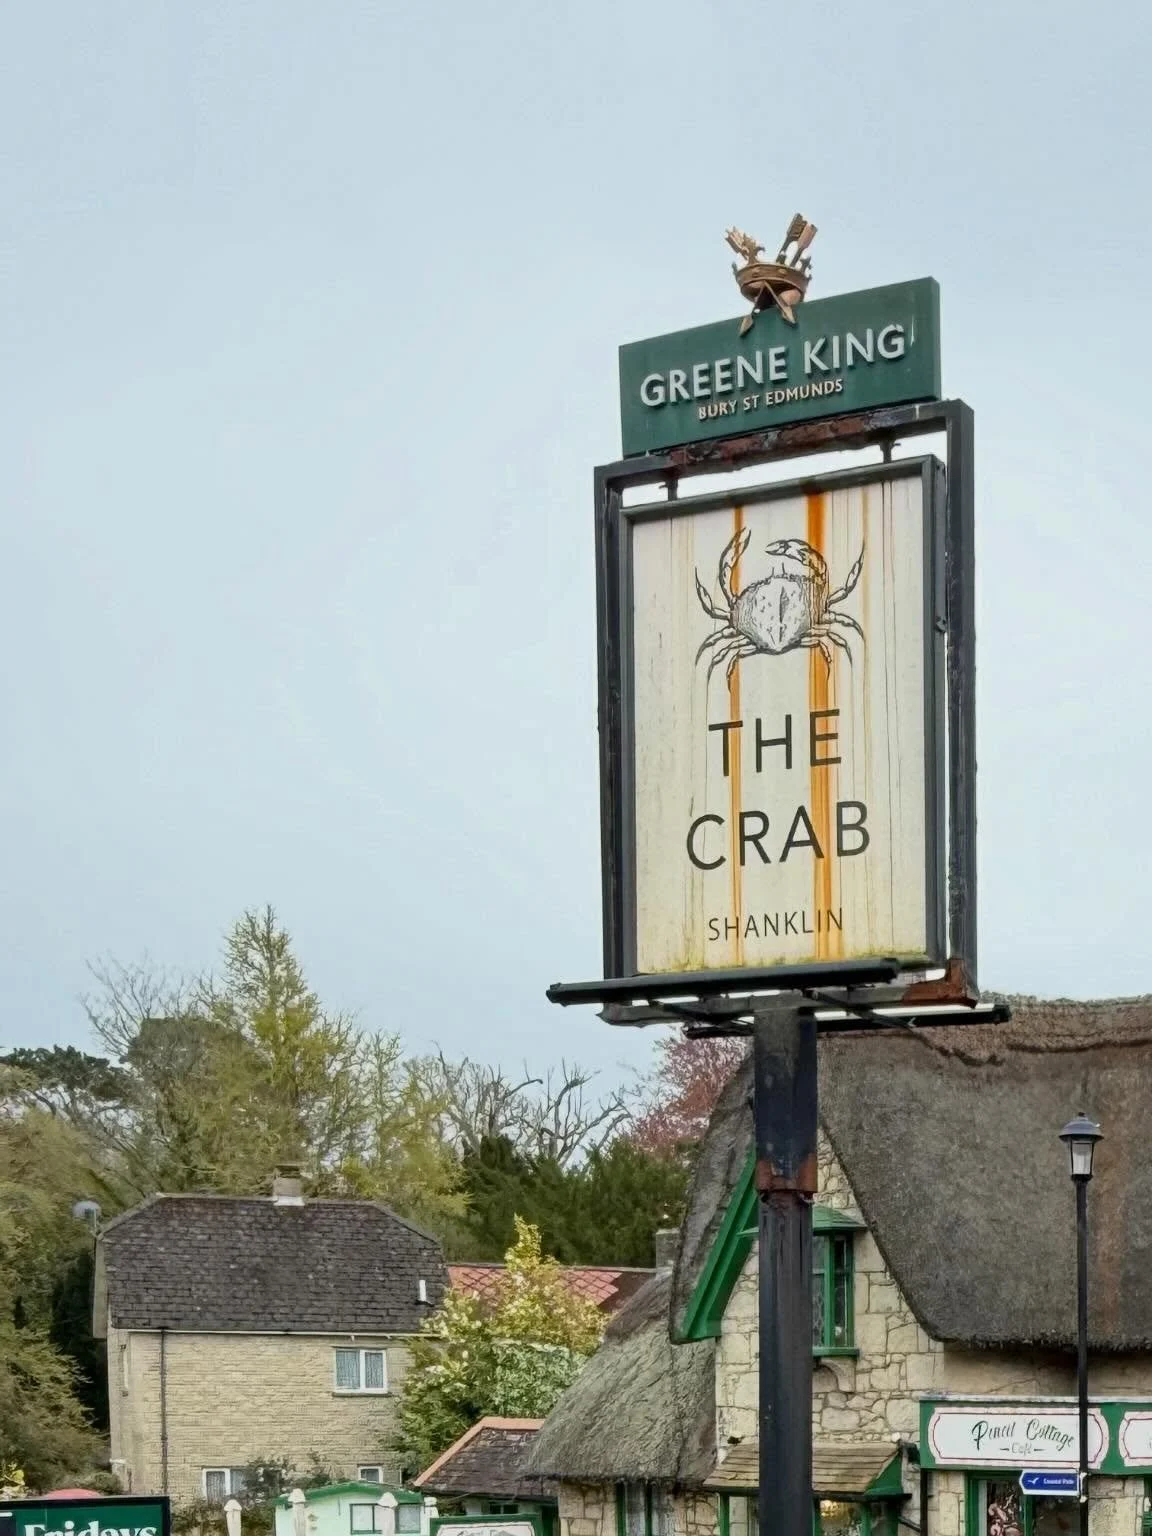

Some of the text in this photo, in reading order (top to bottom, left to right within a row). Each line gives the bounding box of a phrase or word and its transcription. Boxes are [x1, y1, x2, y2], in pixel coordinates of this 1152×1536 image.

[640, 323, 907, 408] GREENE KING
[699, 379, 844, 420] BURY ST EDMUNDS
[708, 708, 842, 777] THE
[686, 800, 871, 871] CRAB
[708, 907, 843, 941] SHANKLIN
[971, 1418, 1074, 1451] Pencil Cottage
